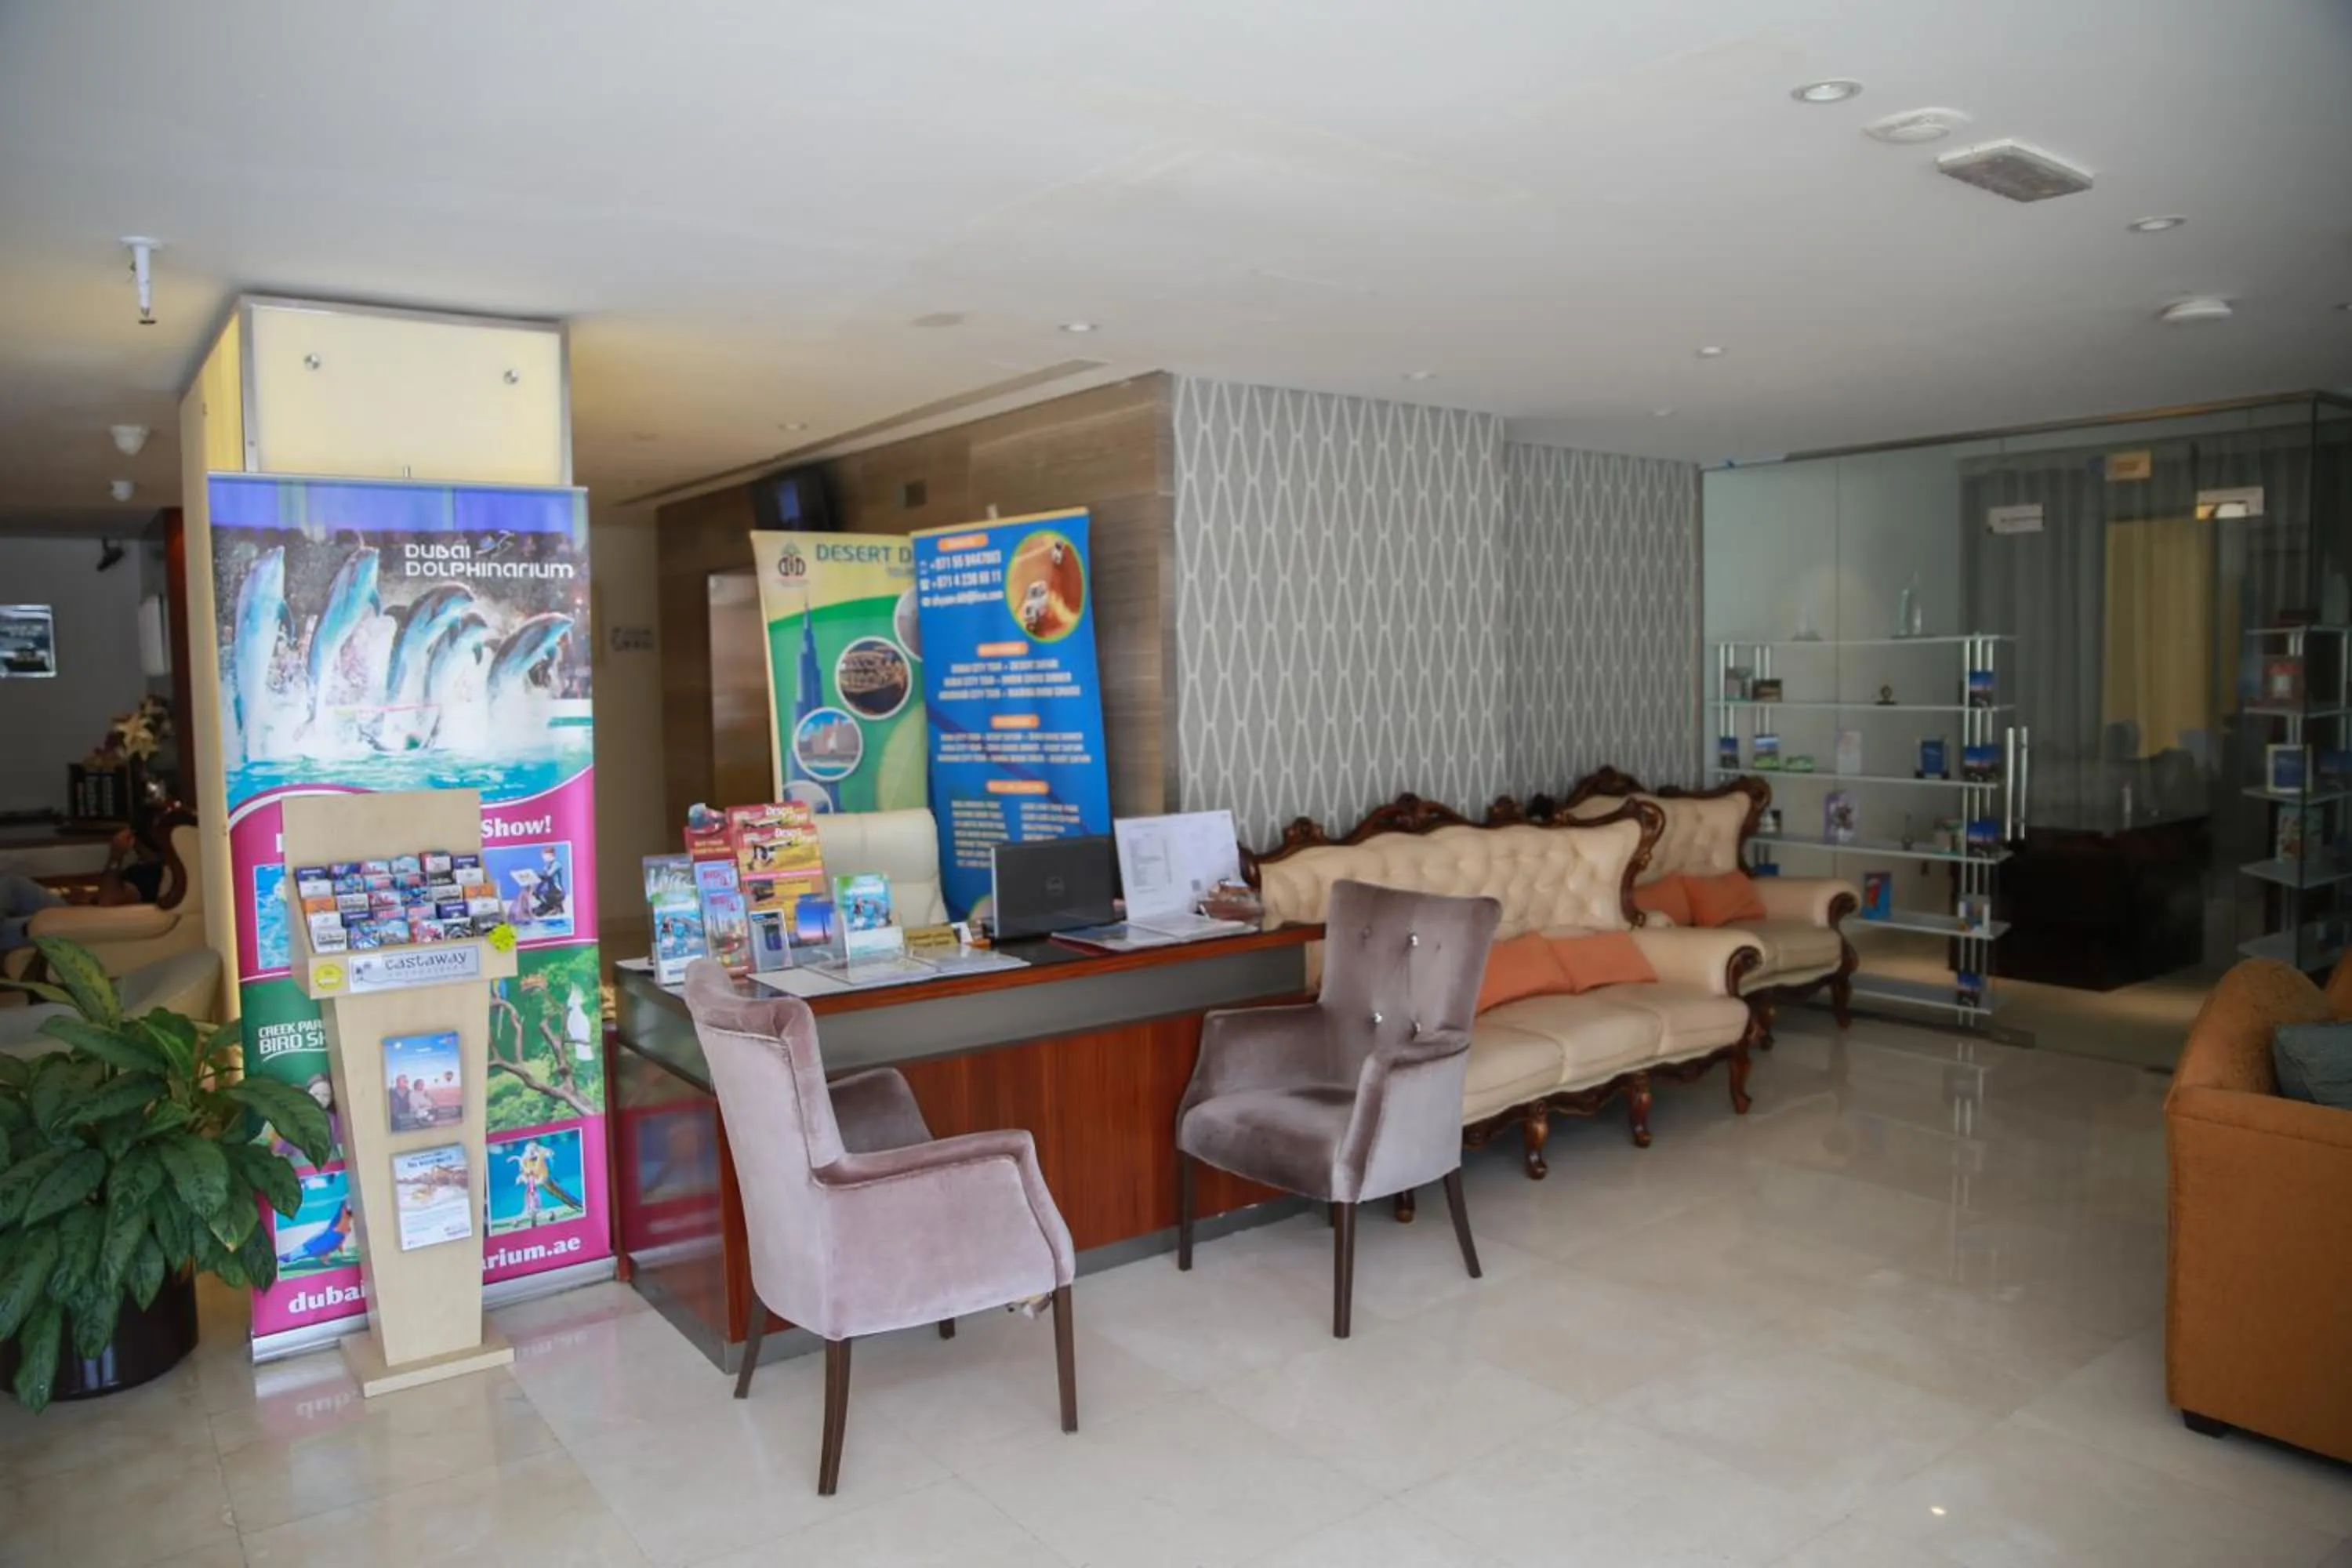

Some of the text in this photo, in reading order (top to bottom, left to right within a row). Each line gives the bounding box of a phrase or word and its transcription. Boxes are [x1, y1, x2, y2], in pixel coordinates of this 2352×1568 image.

[815, 543, 891, 564] DESERT
[481, 815, 552, 839] Show!
[258, 1019, 324, 1038] CREEK PAR
[259, 1033, 303, 1054] BIRD
[482, 1236, 581, 1270] rium.ae
